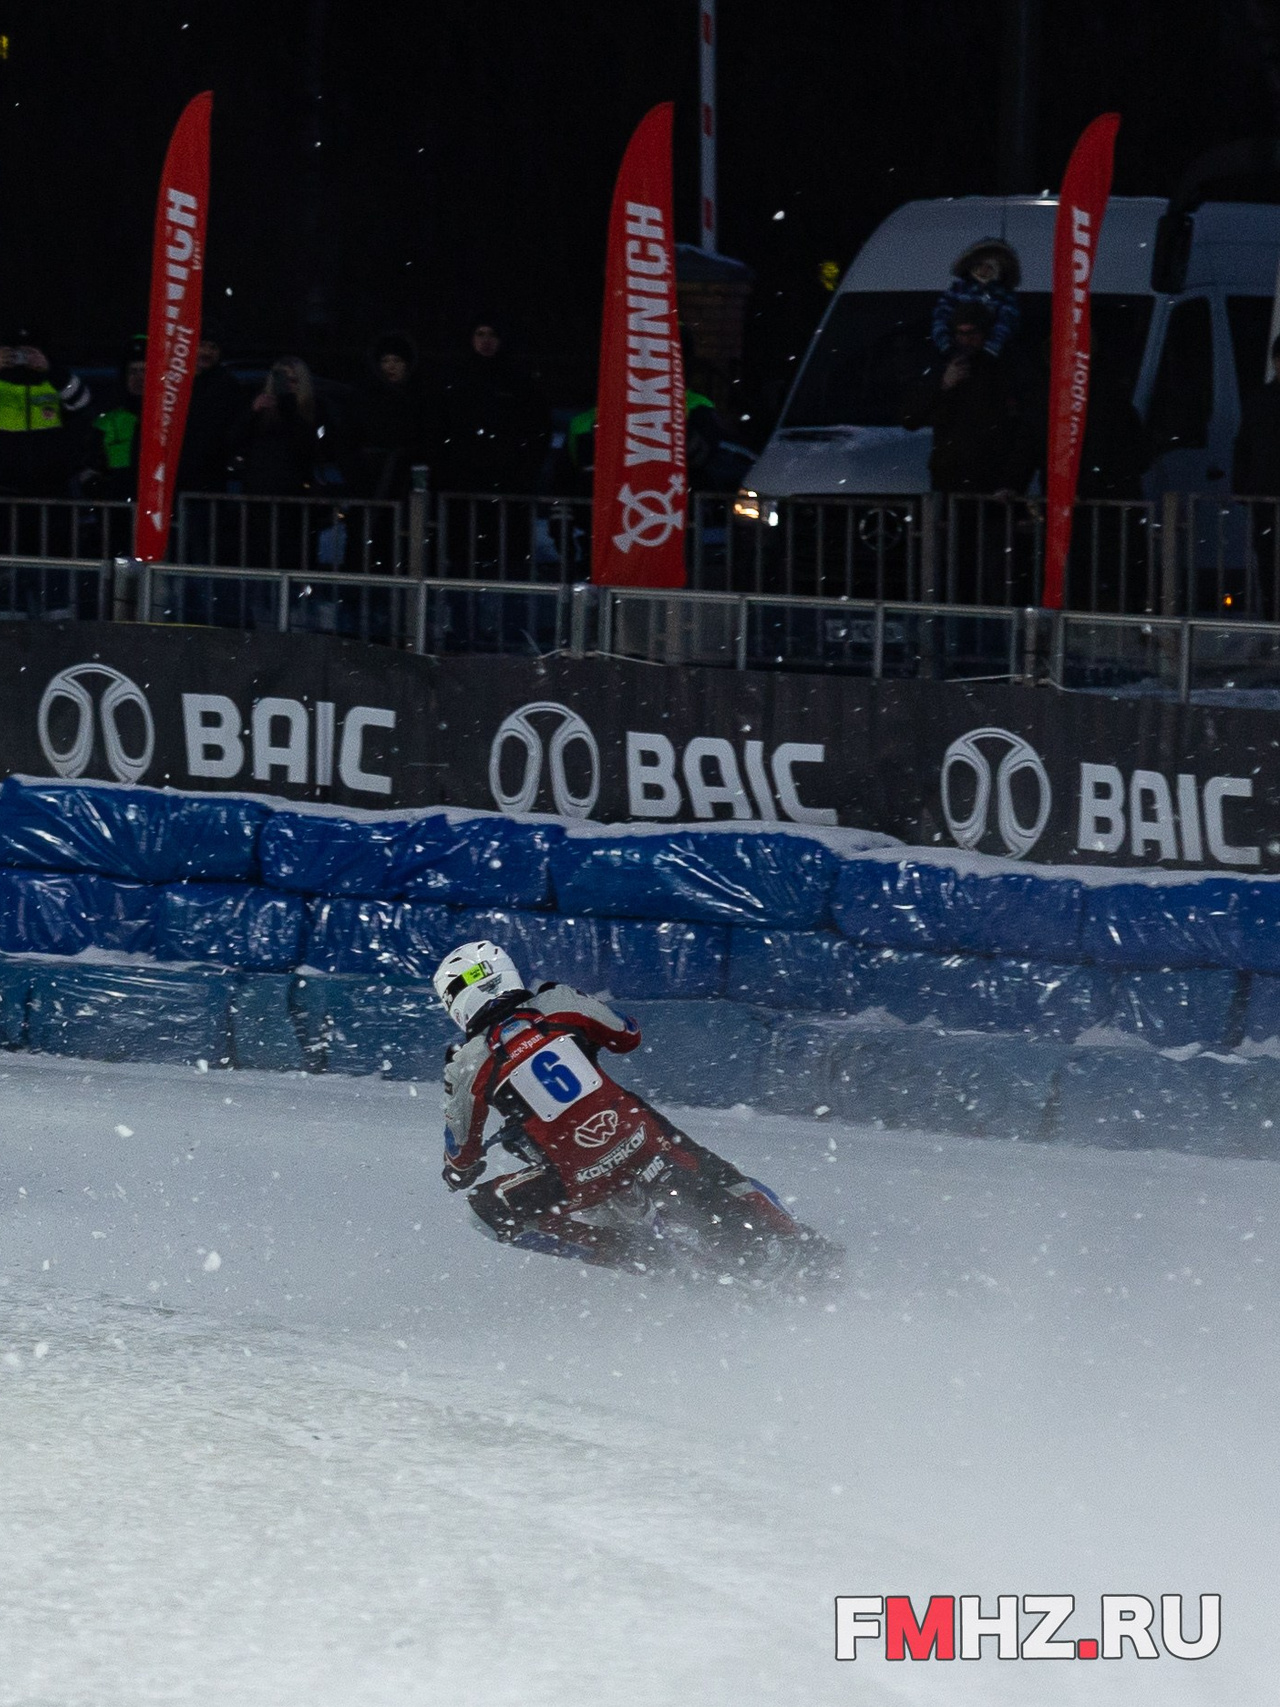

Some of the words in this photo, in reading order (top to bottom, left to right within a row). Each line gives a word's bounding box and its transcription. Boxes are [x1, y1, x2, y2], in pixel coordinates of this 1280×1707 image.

[624, 202, 672, 467] YAKHNICH
[671, 340, 686, 468] motorsport
[180, 693, 397, 795] BAIC
[626, 731, 838, 826] BAIC
[1076, 762, 1262, 865] BAIC
[530, 1050, 582, 1102] 6
[575, 1124, 645, 1183] KOLTAKOV
[641, 1155, 665, 1182] 106
